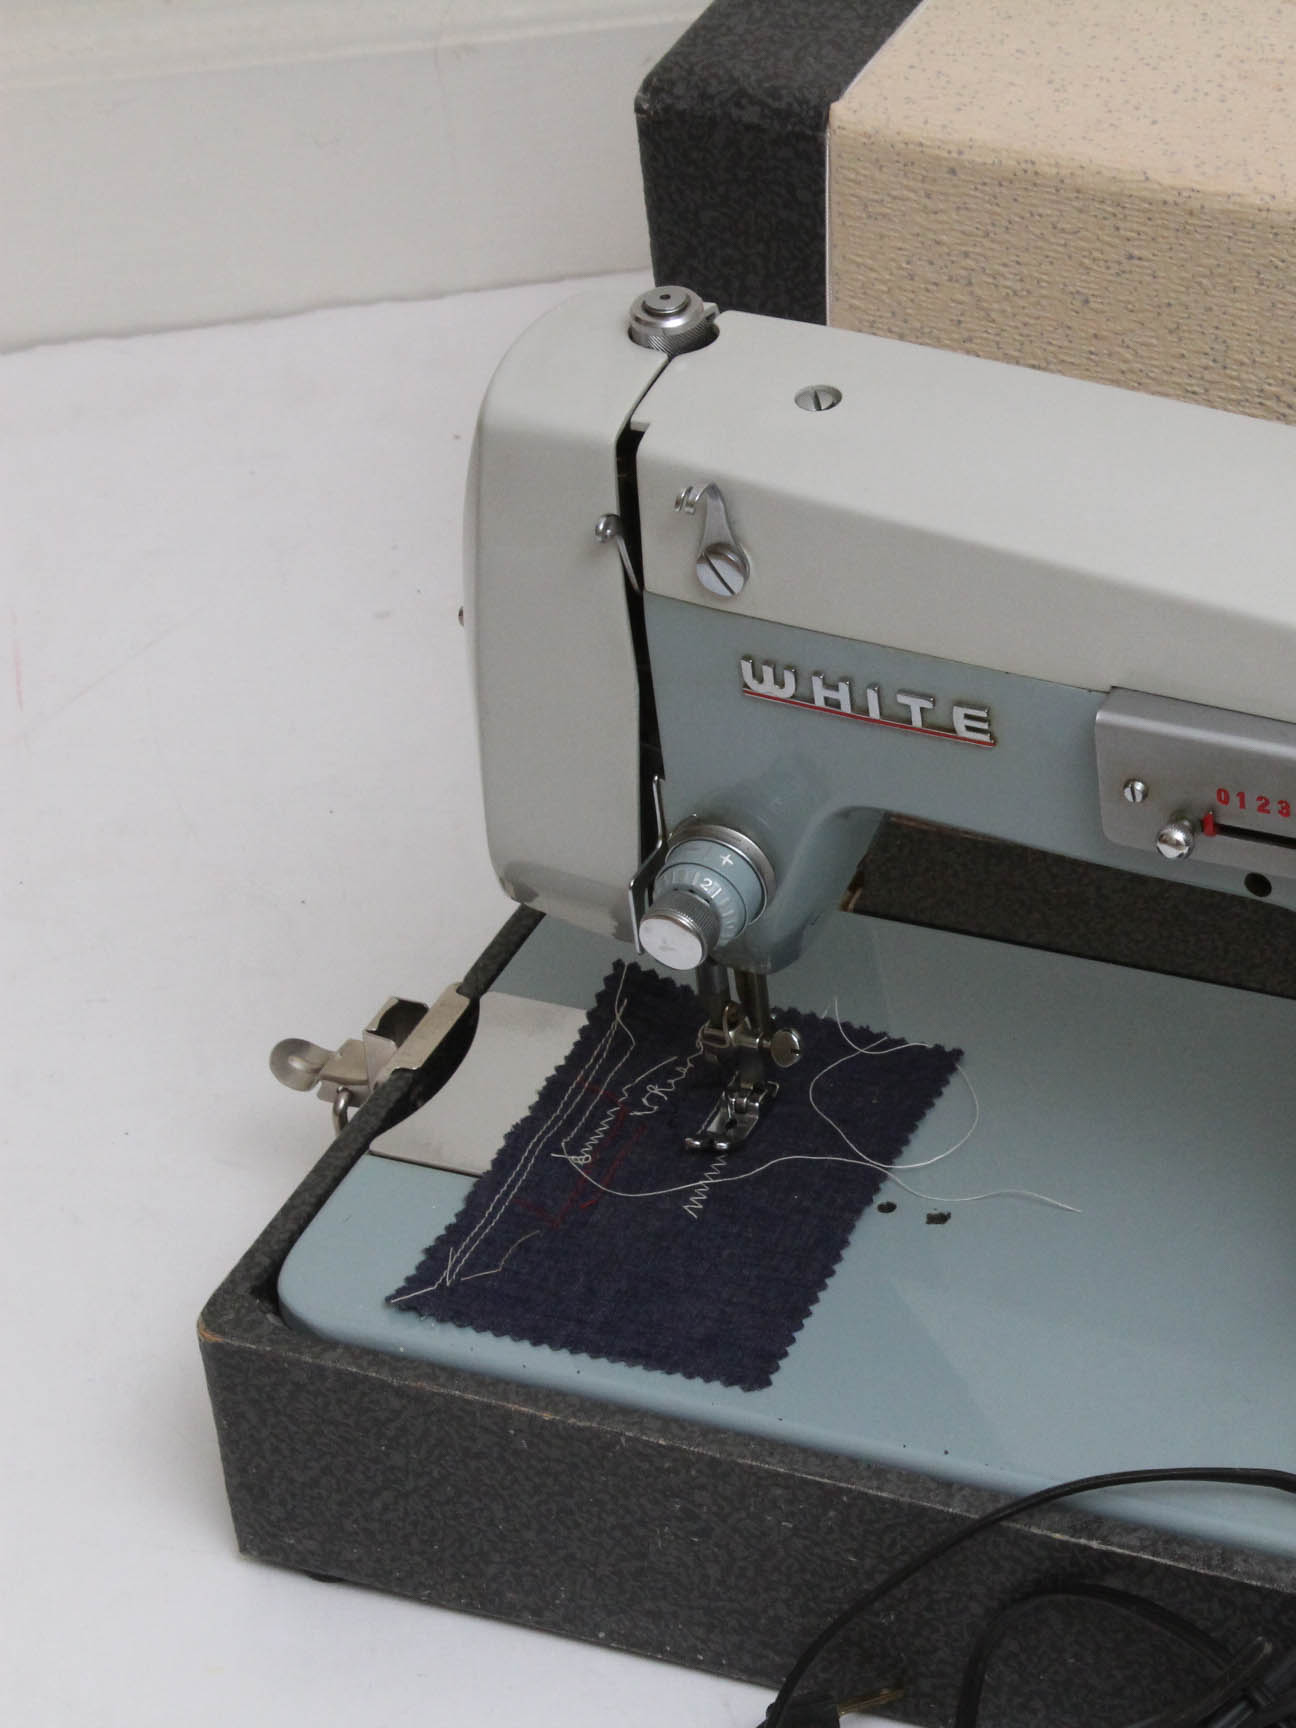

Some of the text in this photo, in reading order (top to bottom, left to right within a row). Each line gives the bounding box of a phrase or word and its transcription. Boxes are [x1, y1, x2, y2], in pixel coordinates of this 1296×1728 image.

[740, 656, 993, 743] WHITE
[1236, 791, 1247, 810] 1
[1256, 796, 1271, 814] 2
[1277, 800, 1291, 818] 3
